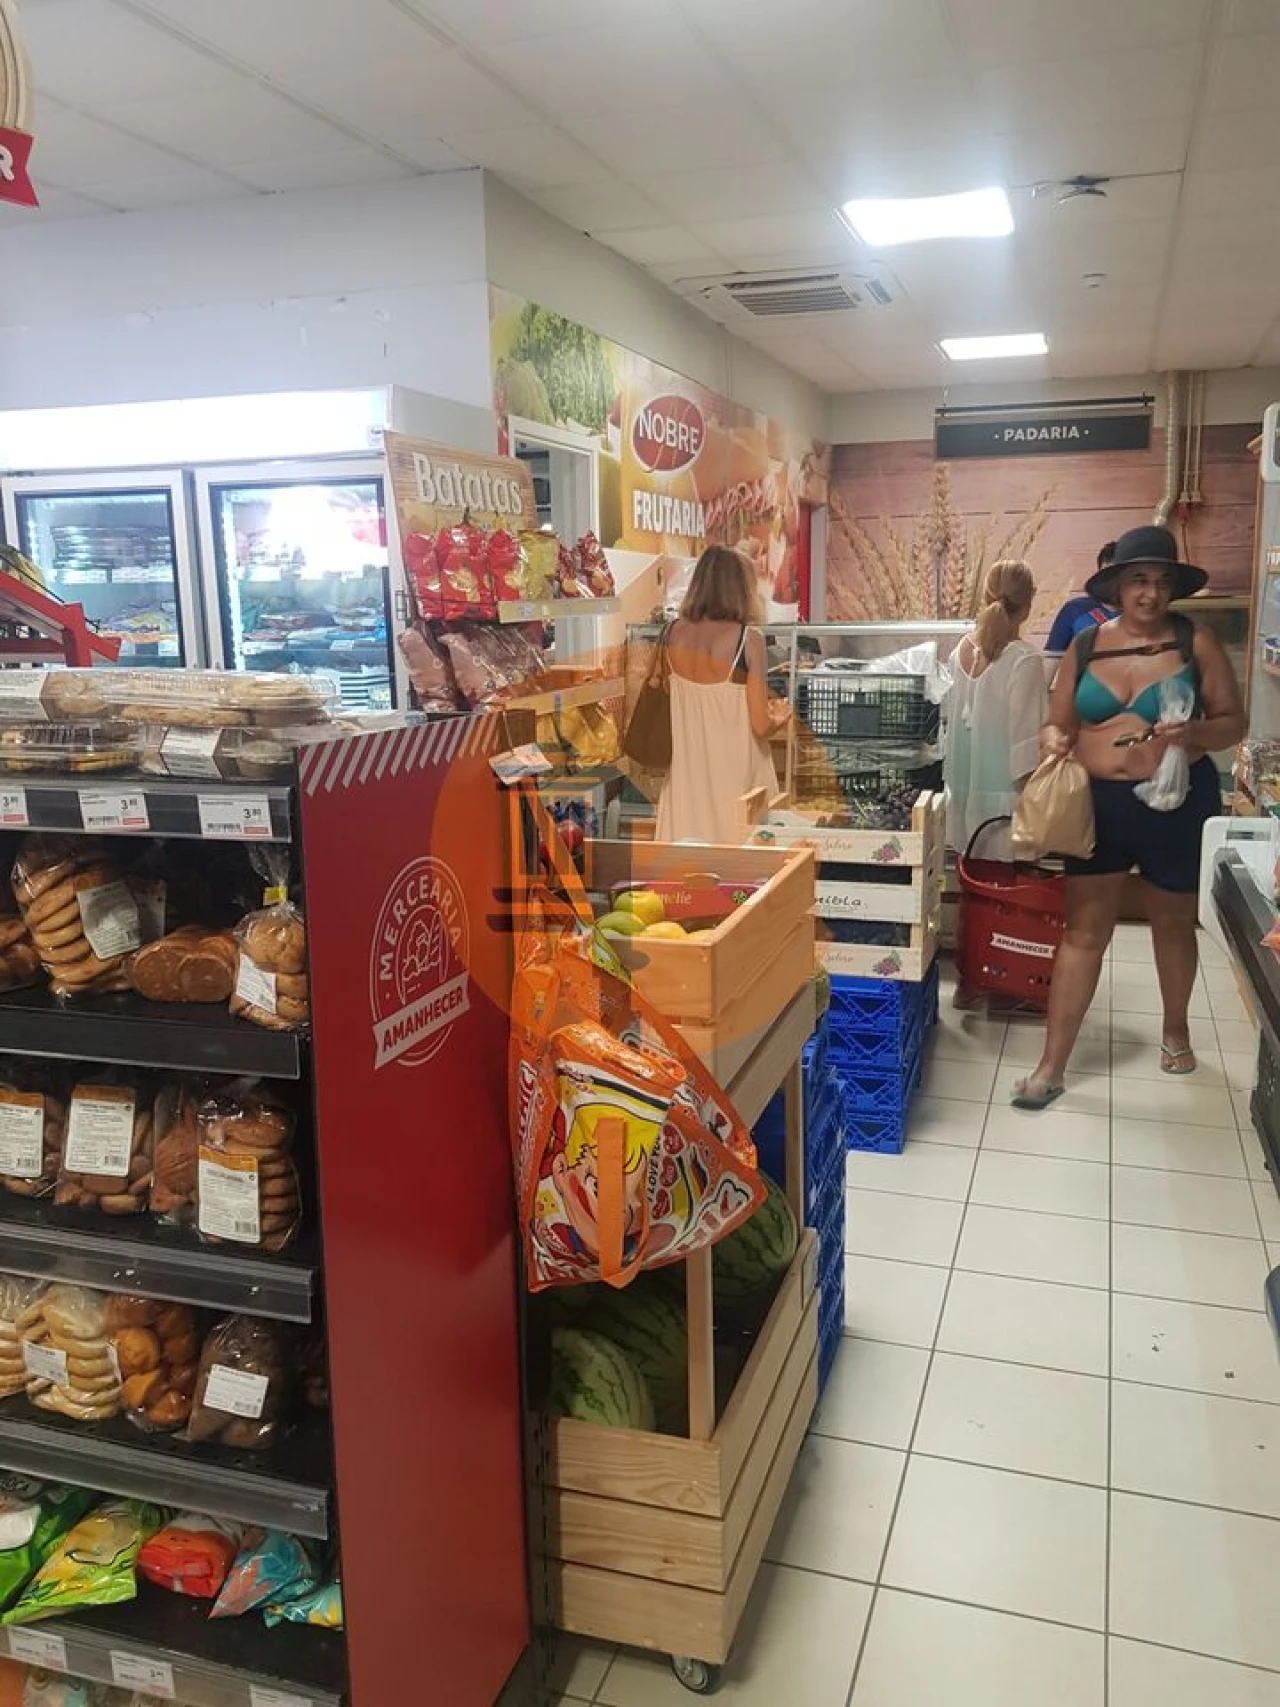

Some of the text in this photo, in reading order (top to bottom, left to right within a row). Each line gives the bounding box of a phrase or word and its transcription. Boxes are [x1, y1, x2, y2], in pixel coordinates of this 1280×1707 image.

[639, 412, 700, 454] NOBRE
[1003, 425, 1080, 442] PADARIA
[412, 451, 524, 515] Batatas
[633, 489, 706, 538] FRUTARIA
[379, 874, 462, 981] MERCEARIA
[995, 937, 1050, 954] AMANHECER
[382, 985, 464, 1053] AMANHECER
